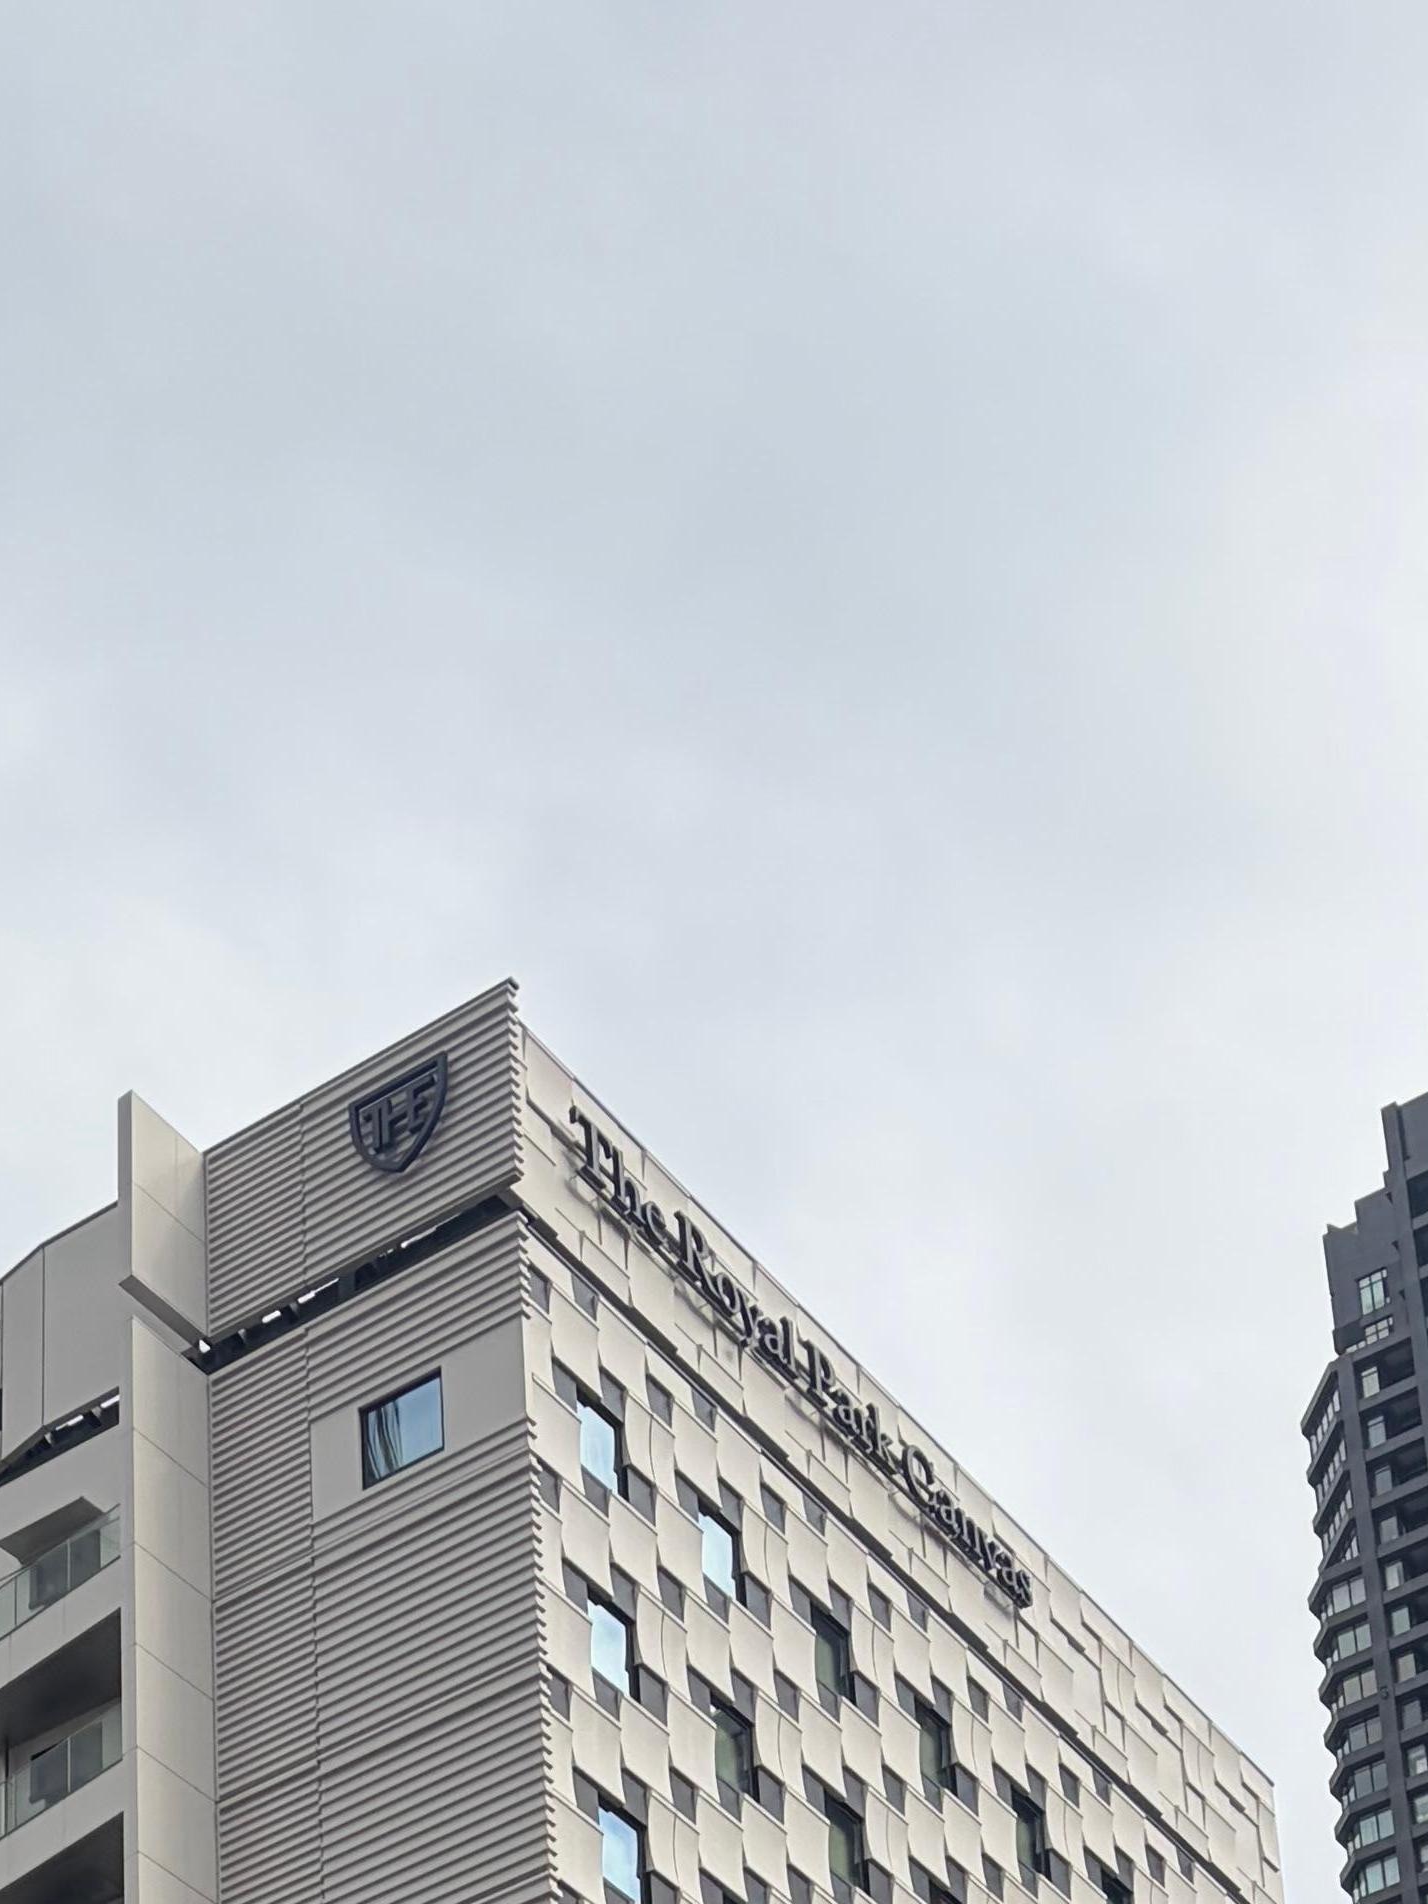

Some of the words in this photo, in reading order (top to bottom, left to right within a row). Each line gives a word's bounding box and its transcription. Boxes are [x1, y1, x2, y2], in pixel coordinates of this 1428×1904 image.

[358, 1074, 436, 1155] THE
[569, 1105, 667, 1246] The
[673, 1210, 798, 1379] Royal
[803, 1339, 901, 1475] Park
[902, 1445, 1032, 1608] Canvas
